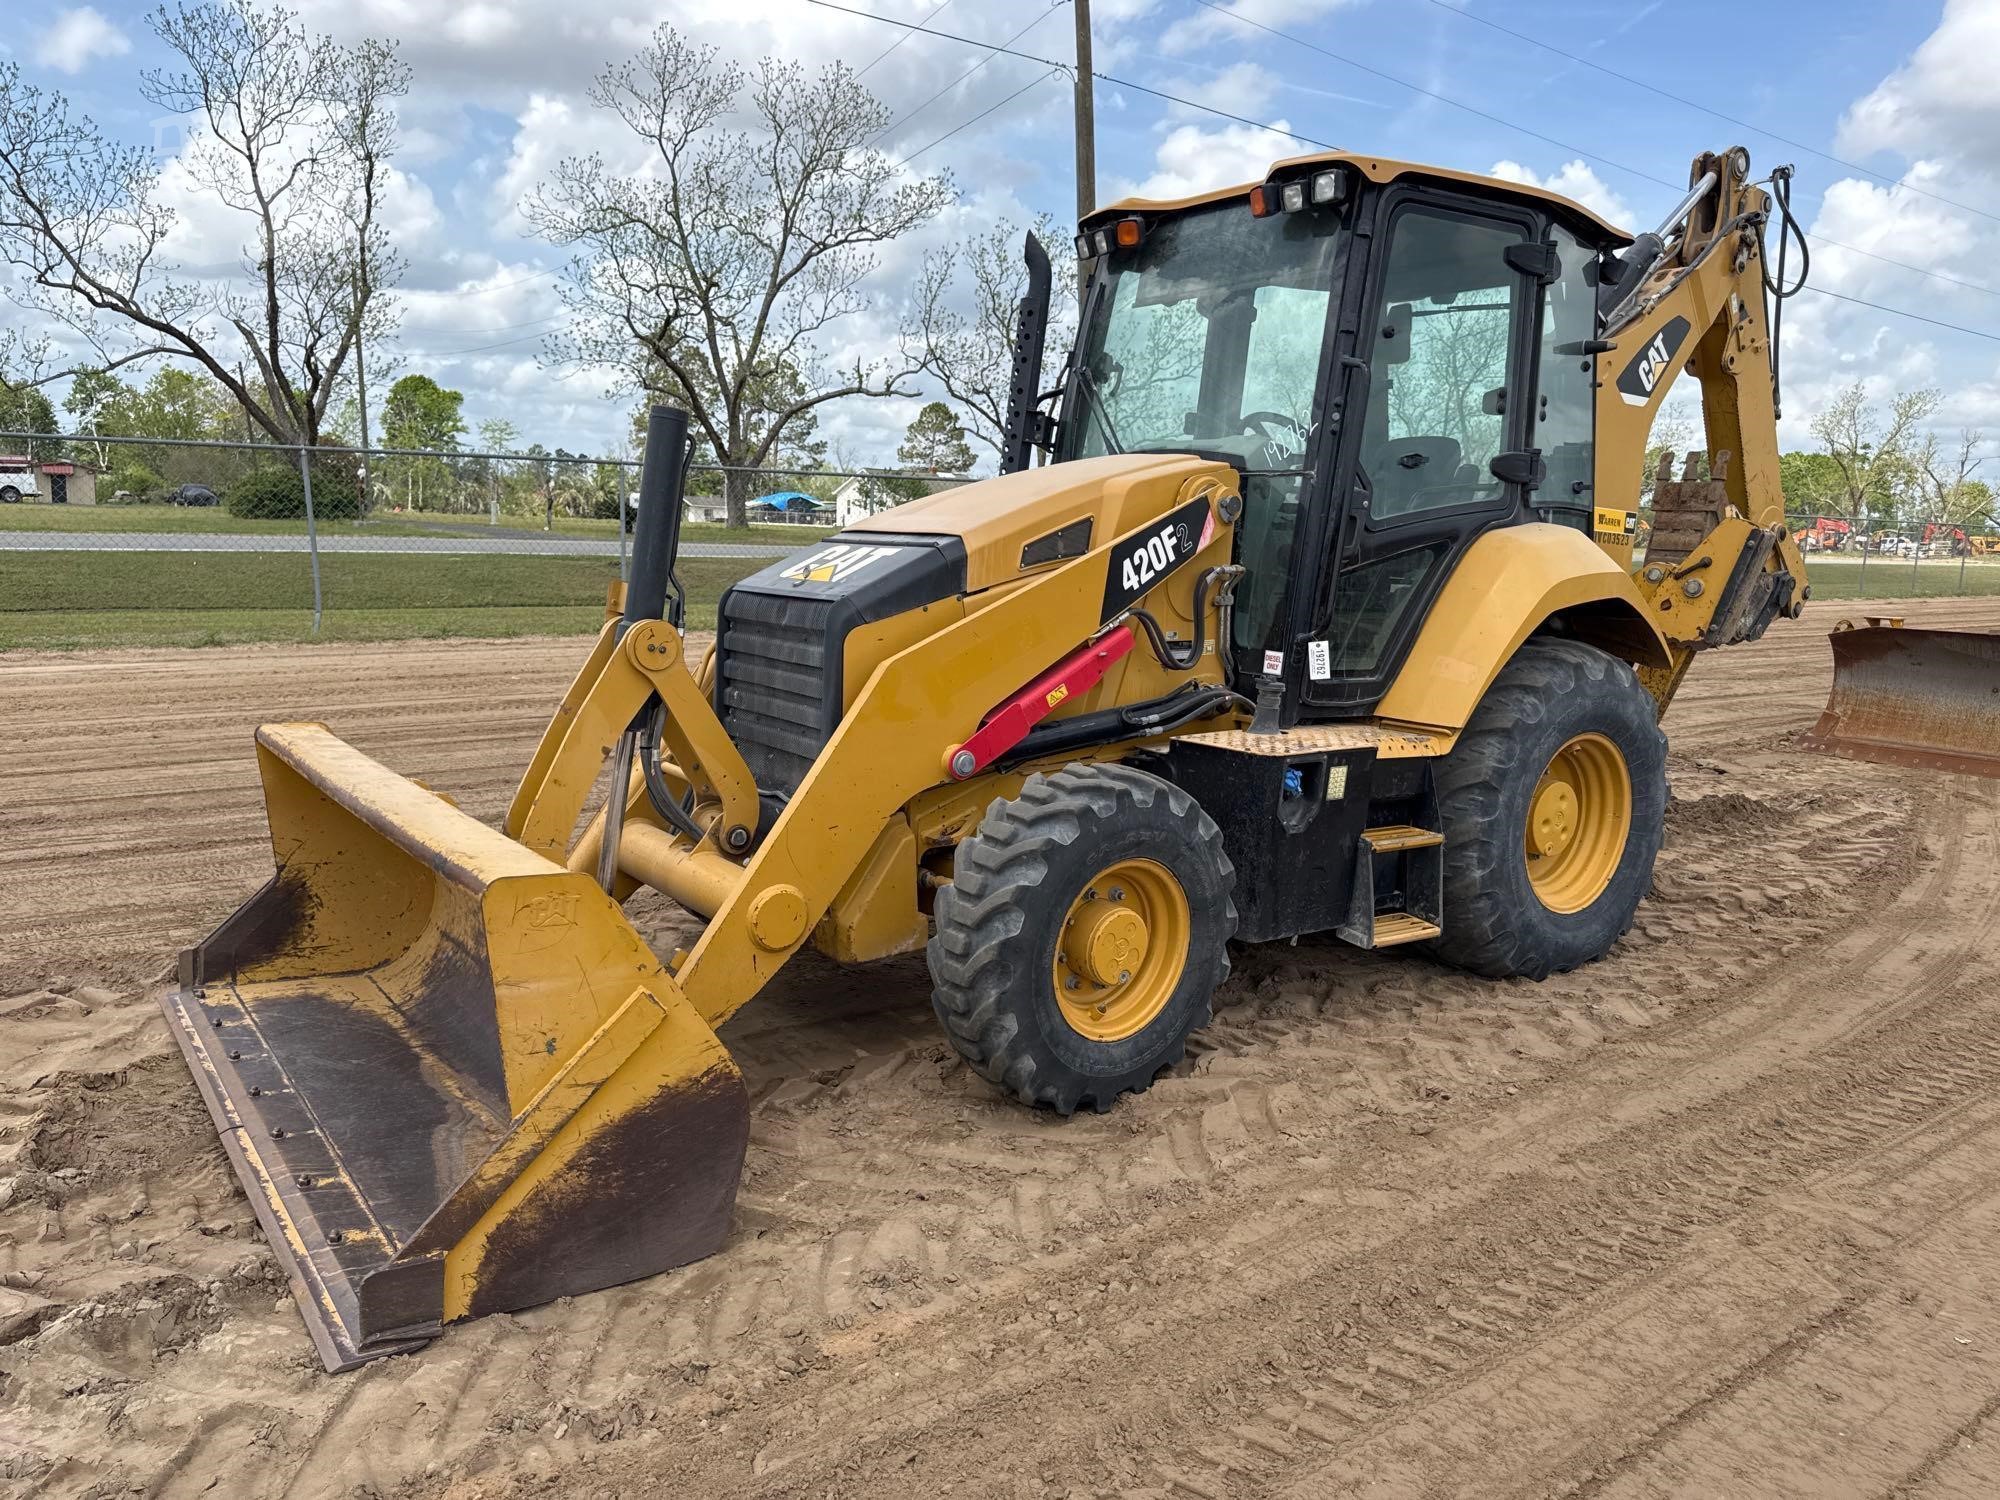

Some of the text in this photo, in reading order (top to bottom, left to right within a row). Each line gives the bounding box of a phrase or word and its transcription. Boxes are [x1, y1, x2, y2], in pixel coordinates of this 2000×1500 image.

[1638, 332, 1669, 391] CAT
[1263, 410, 1318, 467] 192762
[779, 545, 903, 582] CAT
[1122, 523, 1193, 591] 420F2
[1265, 654, 1282, 663] DIESEL
[1266, 662, 1279, 670] ONLY
[1316, 650, 1326, 675] 192762
